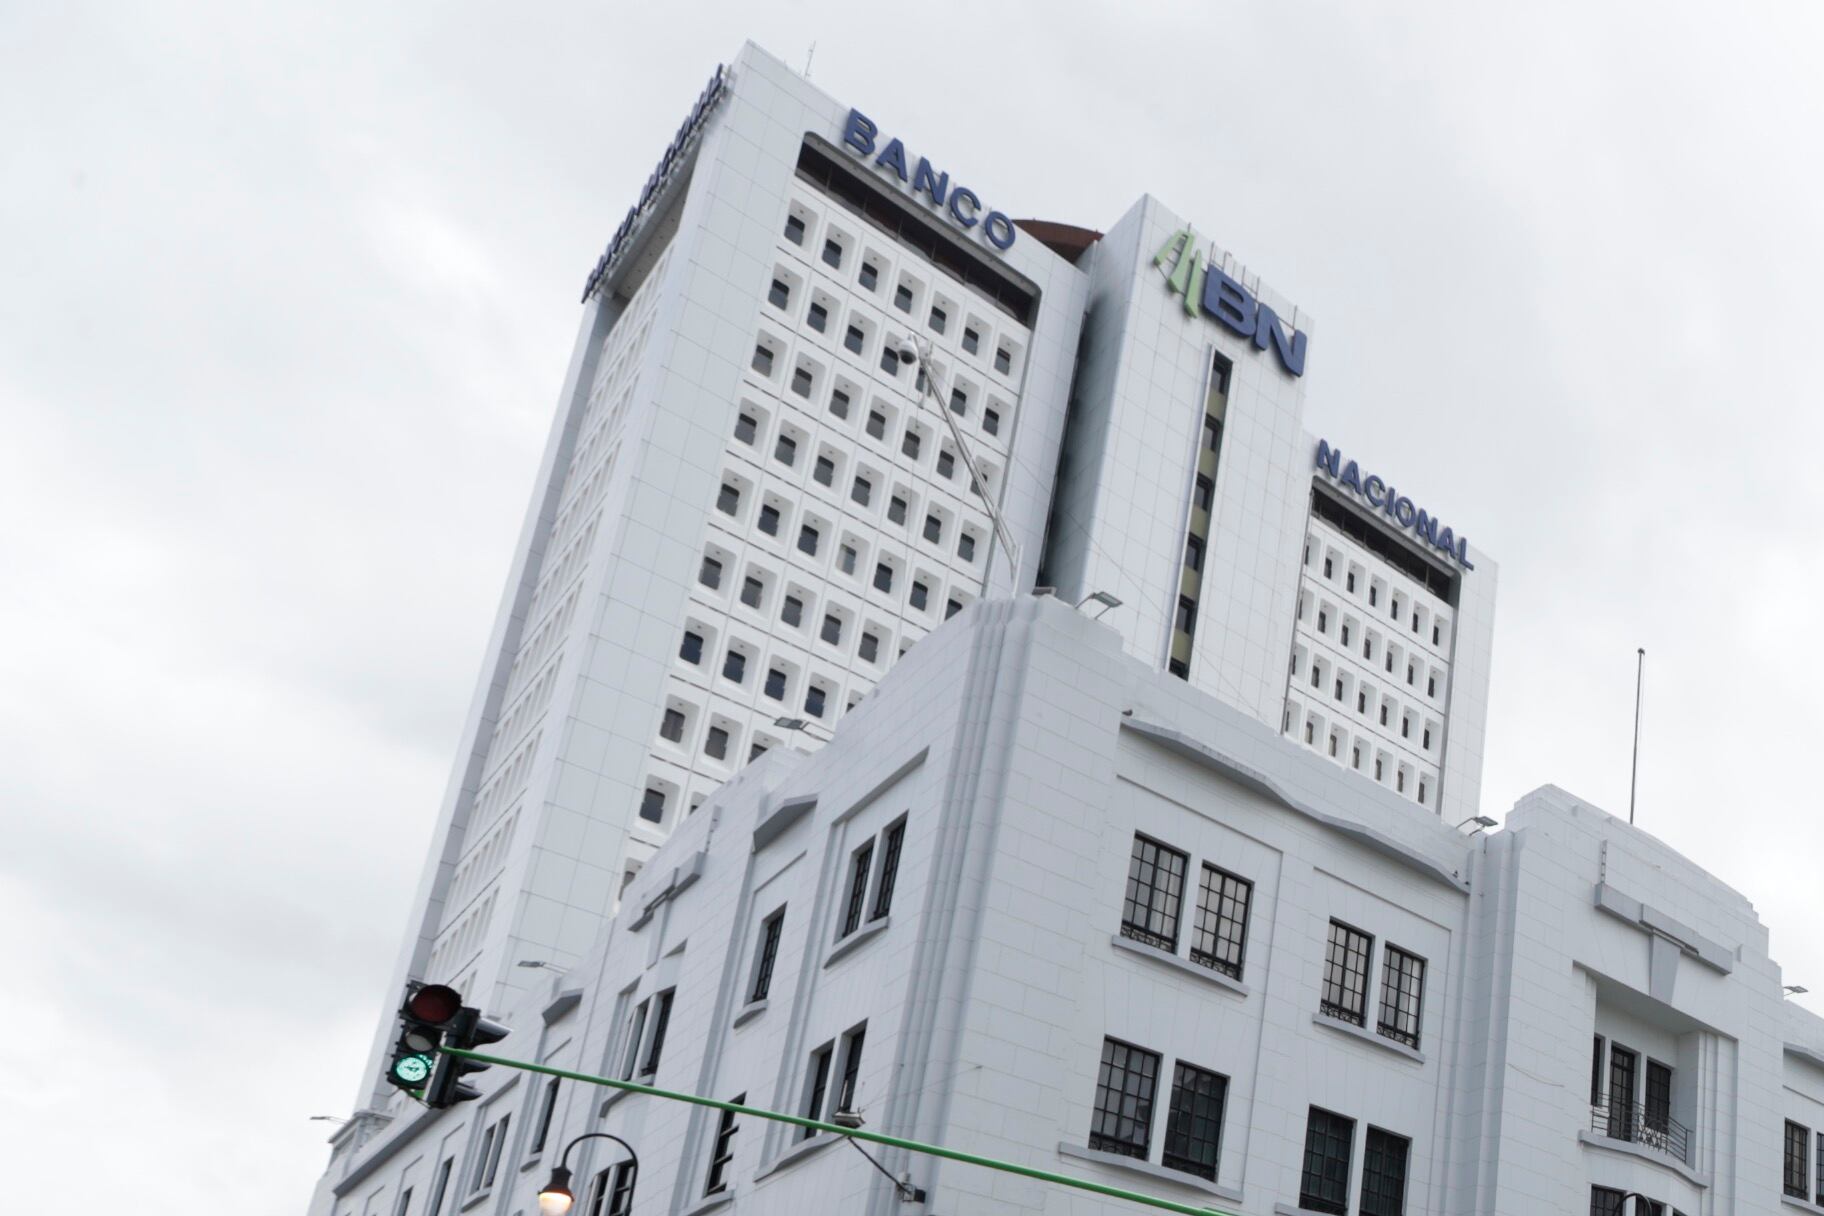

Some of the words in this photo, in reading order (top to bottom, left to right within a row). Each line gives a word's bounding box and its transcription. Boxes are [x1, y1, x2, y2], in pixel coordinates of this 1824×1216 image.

[843, 108, 1016, 250] BANCO
[1200, 263, 1308, 377] BN
[1316, 438, 1475, 571] NACIONAL
